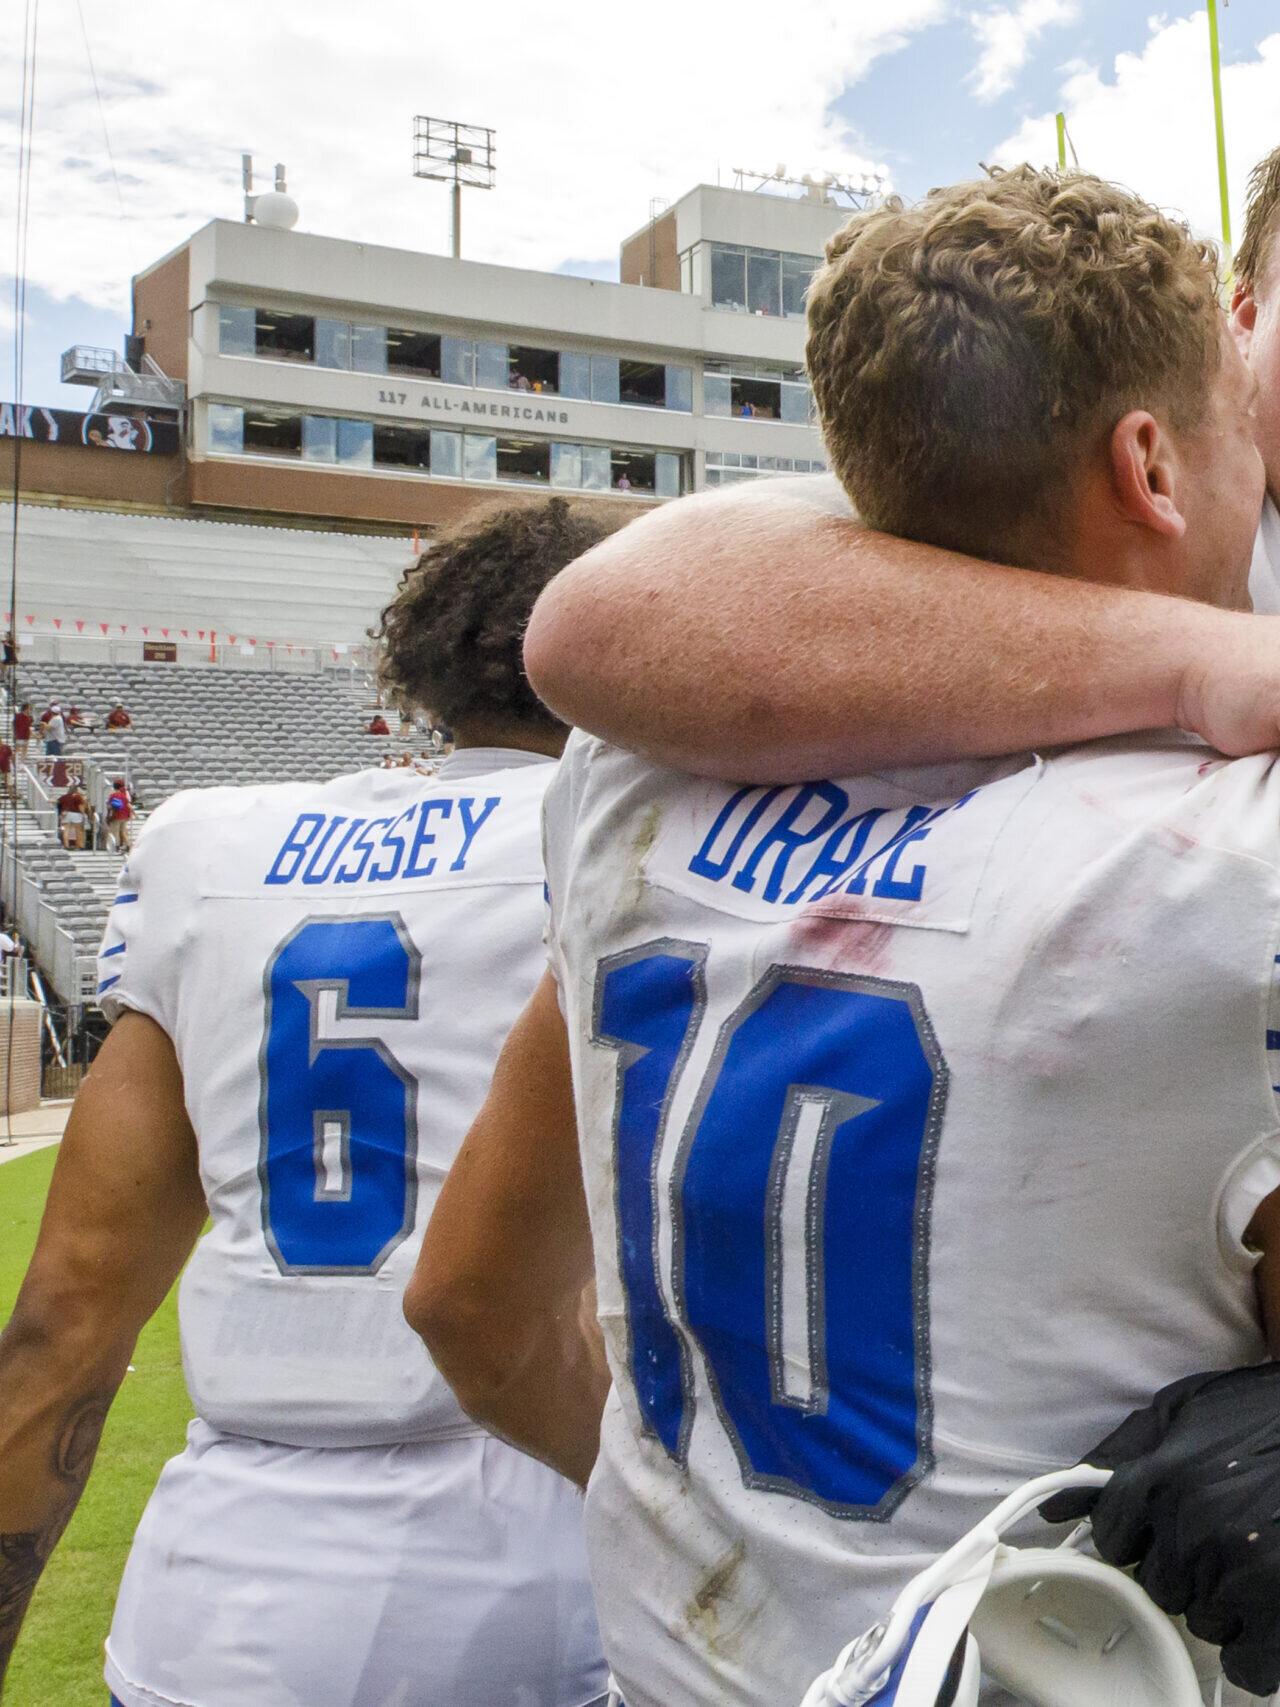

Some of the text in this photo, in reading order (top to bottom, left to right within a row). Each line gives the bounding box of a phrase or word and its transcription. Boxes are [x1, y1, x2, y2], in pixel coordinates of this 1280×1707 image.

[379, 390, 569, 424] 117 ALL-AMERICANS
[38, 762, 82, 777] 27 28
[264, 796, 501, 885] BUSSEY
[258, 911, 422, 1277] 6
[592, 936, 951, 1523] 10
